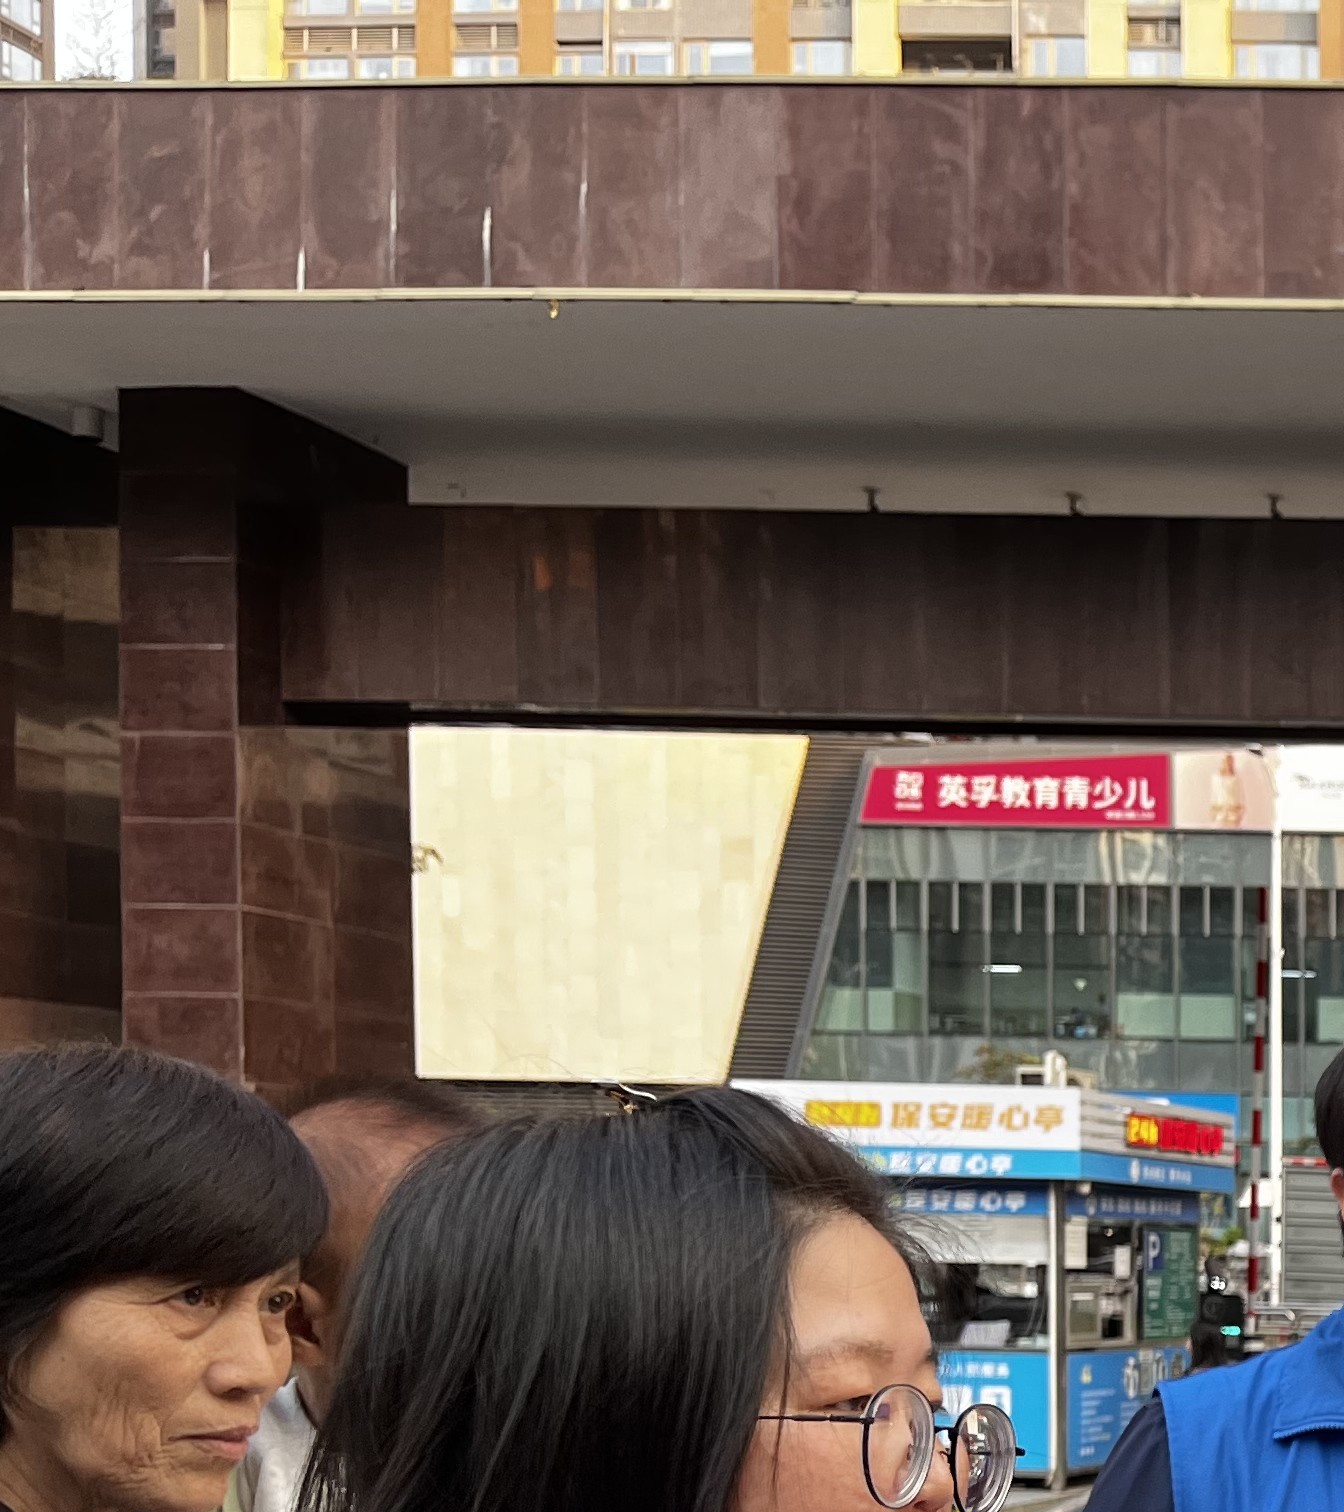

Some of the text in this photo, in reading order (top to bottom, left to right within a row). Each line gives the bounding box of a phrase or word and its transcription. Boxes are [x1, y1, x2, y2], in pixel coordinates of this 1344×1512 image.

[937, 773, 1156, 811] 英孚教育青少儿
